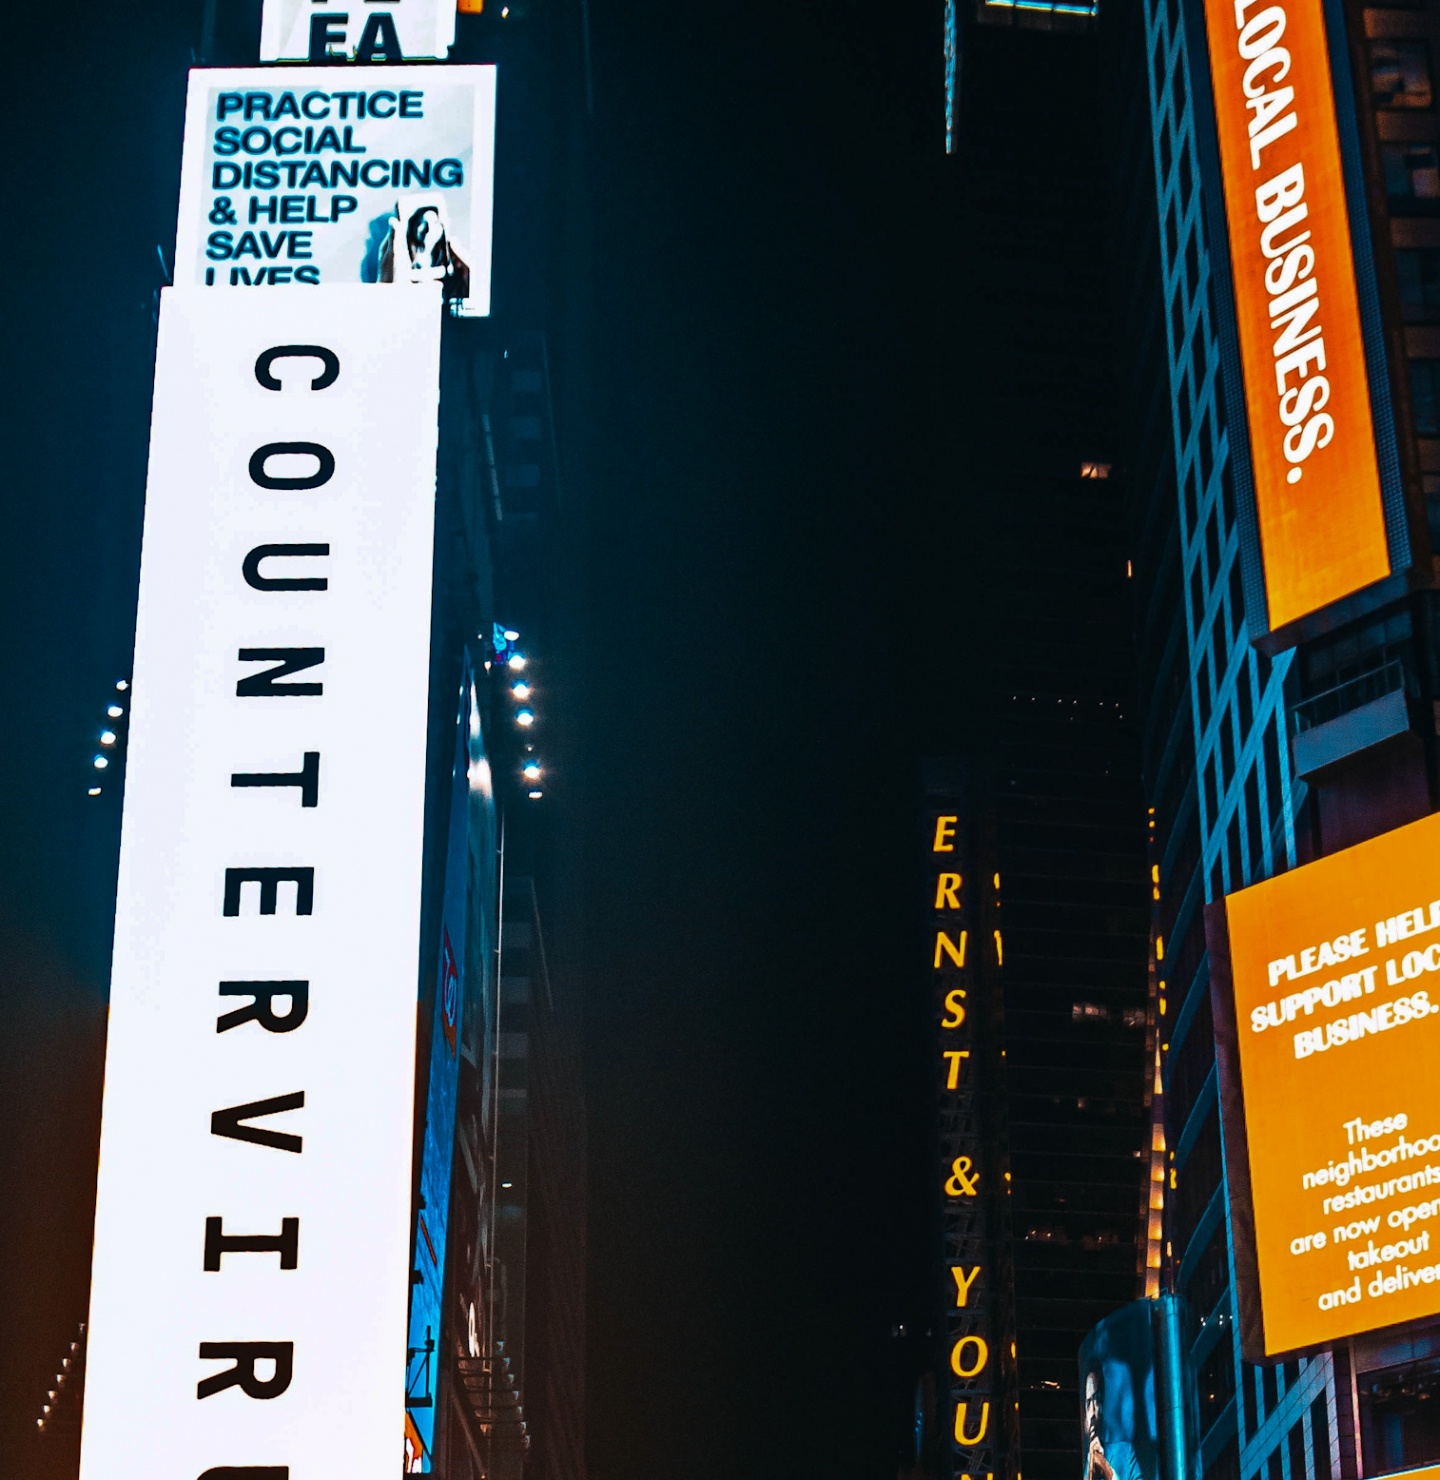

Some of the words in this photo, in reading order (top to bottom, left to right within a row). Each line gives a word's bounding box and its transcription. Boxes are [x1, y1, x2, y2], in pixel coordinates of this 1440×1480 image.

[216, 90, 424, 121] PRACTICE
[213, 125, 366, 156] SOCIAL
[212, 158, 464, 190] DISTANCING
[208, 197, 237, 225] &
[248, 195, 358, 224] HELP
[206, 230, 313, 260] SAVE
[205, 264, 320, 286] LIVES
[1255, 162, 1335, 485] BUSINESS.
[932, 815, 969, 1091] ERNST
[1268, 928, 1370, 986] PLEASE
[1251, 965, 1378, 1033] SUPPORT
[1293, 991, 1440, 1060] BUSINESS.
[1343, 1113, 1408, 1145] These
[943, 1157, 981, 1197] &
[1290, 1232, 1327, 1255] are
[1333, 1216, 1381, 1244] now
[1347, 1230, 1430, 1271] takeout
[1318, 1276, 1362, 1311] and
